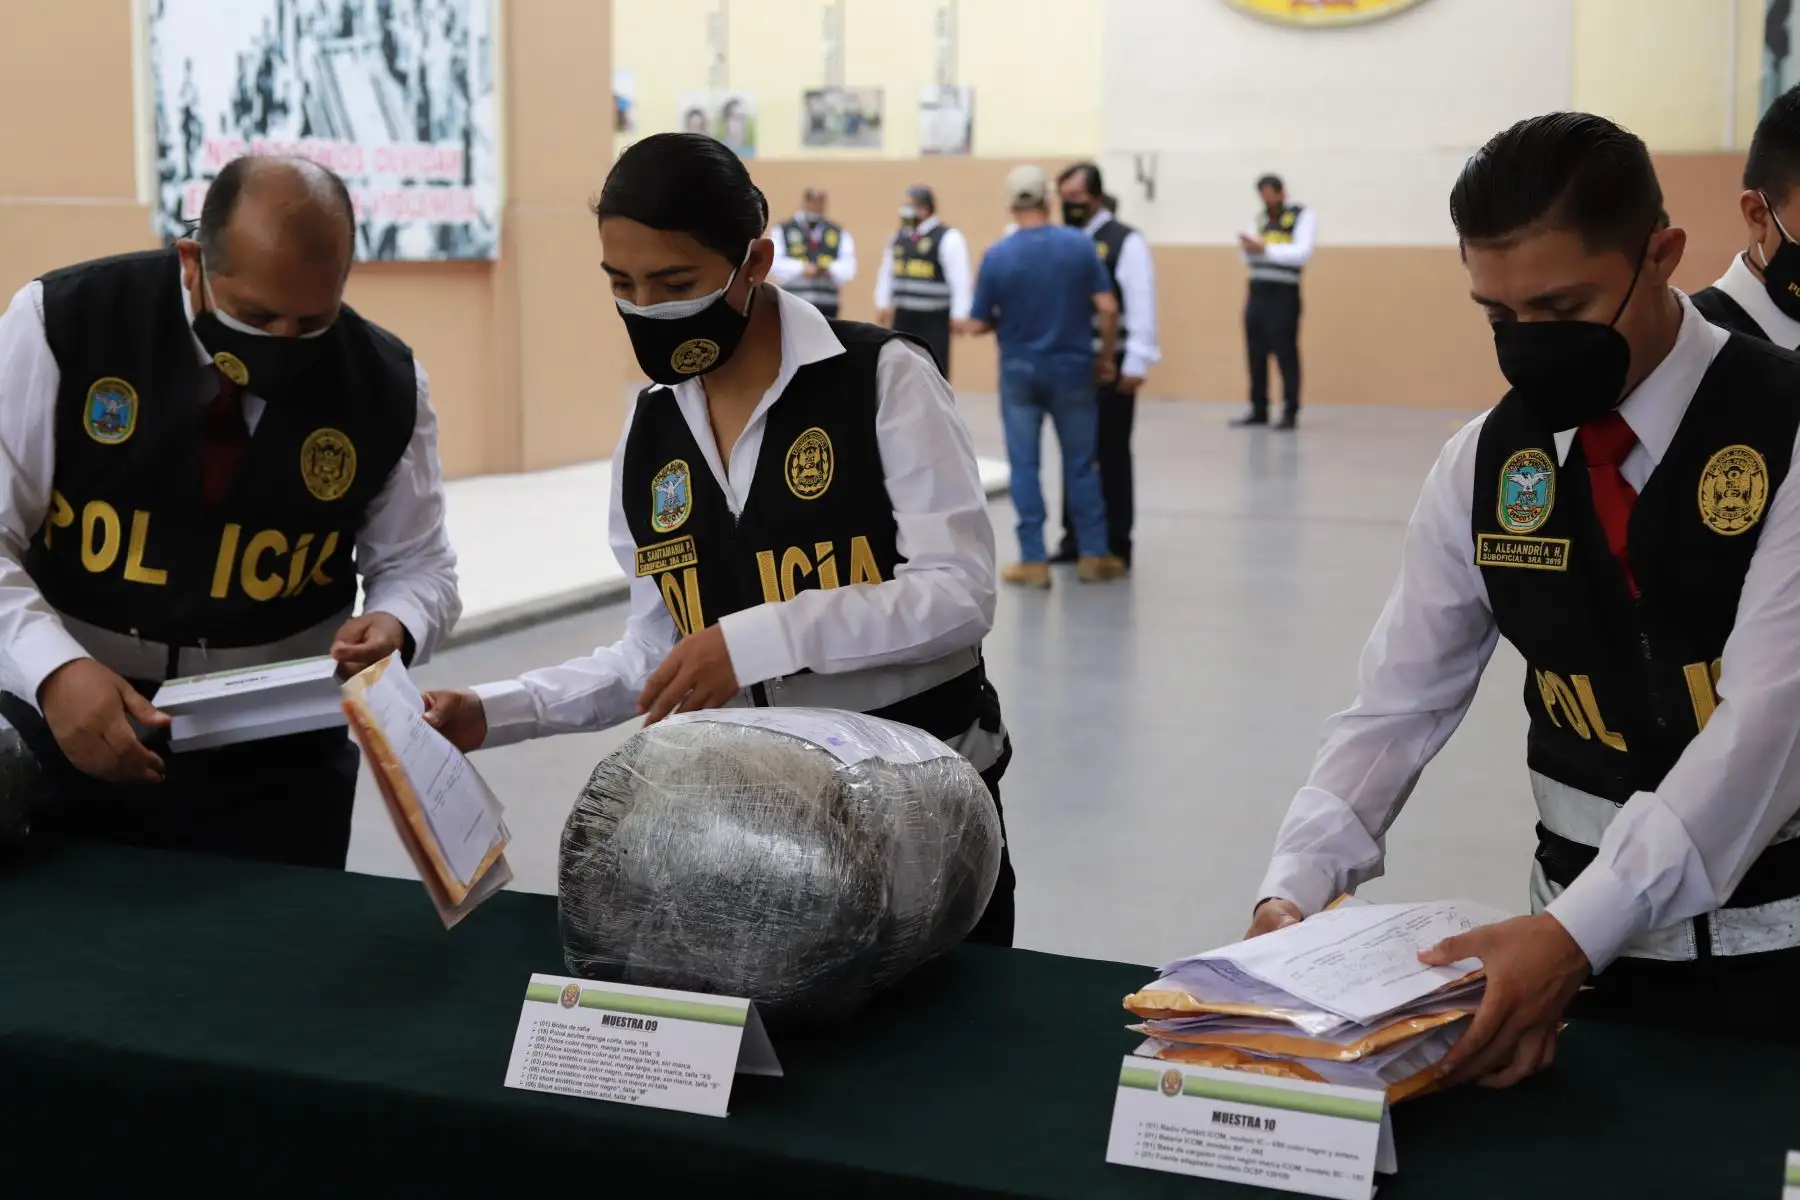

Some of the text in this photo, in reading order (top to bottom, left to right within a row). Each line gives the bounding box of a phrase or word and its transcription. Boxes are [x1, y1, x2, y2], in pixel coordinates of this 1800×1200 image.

[1483, 541, 1491, 552] S.
[1482, 553, 1524, 562] SUBOFICIAL
[1528, 556, 1541, 564] 3RA
[601, 1014, 658, 1031] MUESTRA 09
[1211, 1110, 1276, 1131] MUESTRA 10
